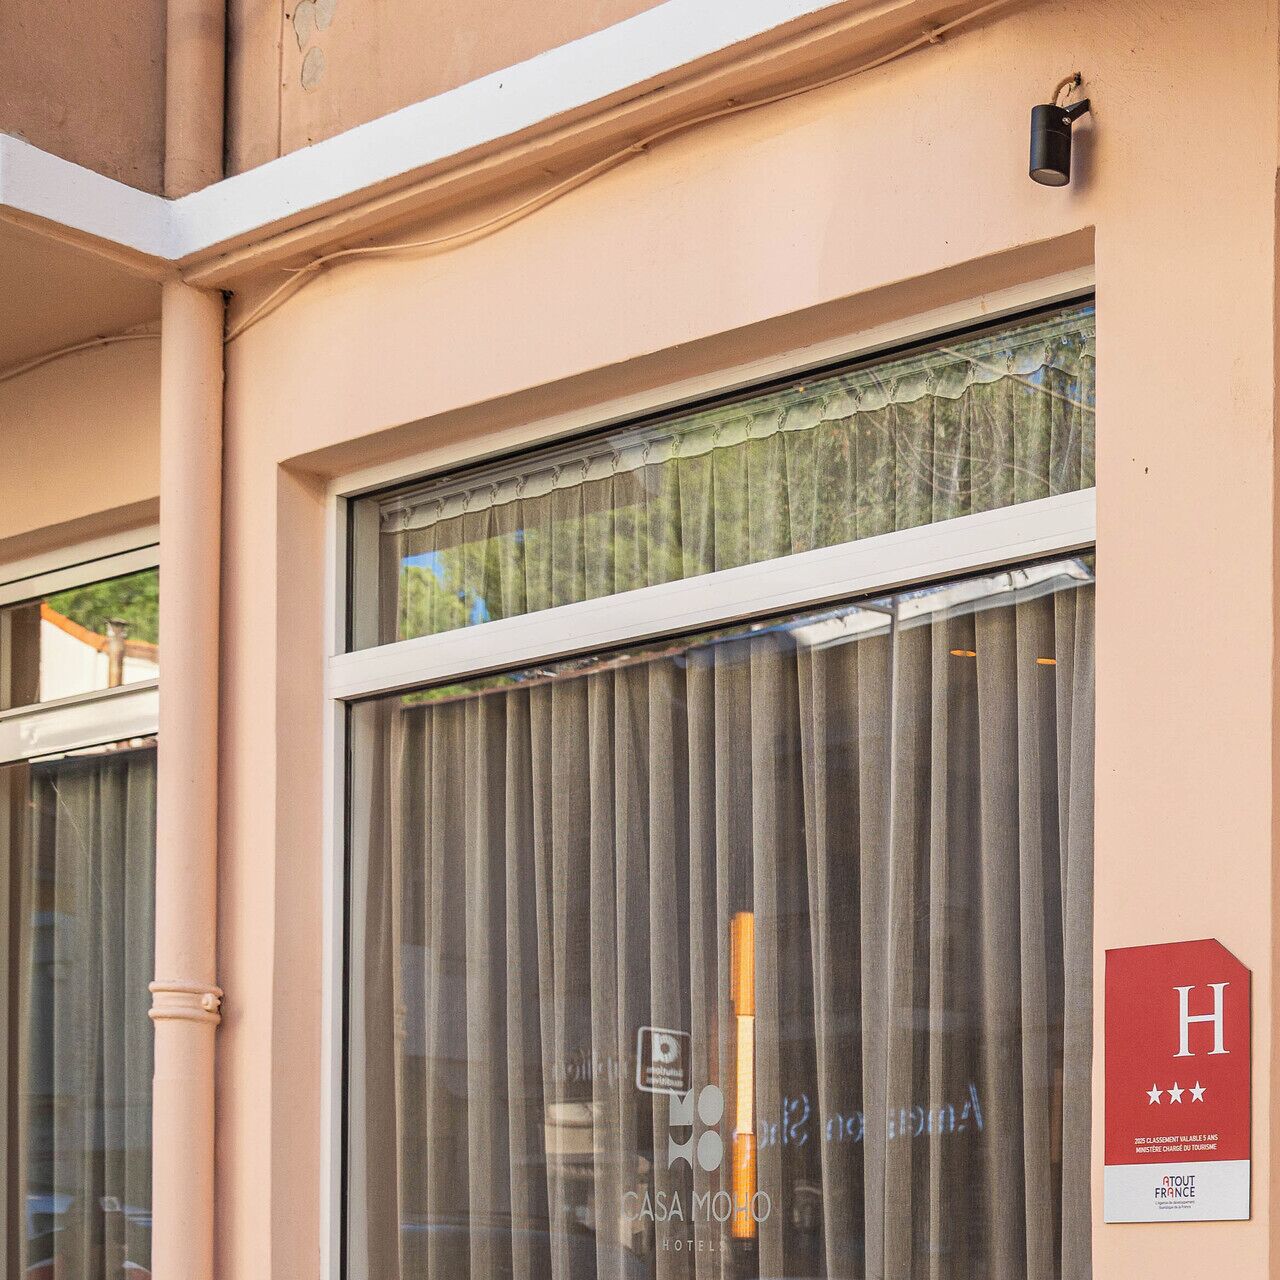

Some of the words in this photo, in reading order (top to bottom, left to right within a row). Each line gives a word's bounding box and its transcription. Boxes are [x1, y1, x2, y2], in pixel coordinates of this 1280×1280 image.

[1173, 982, 1230, 1058] H
[1146, 1136, 1180, 1144] CLASSEMENT
[1180, 1134, 1203, 1142] VALABLE
[1207, 1133, 1219, 1141] ANS
[1192, 1143, 1218, 1151] TOURISME
[1162, 1175, 1196, 1187] ATOUT
[1154, 1187, 1196, 1198] FRANCE
[622, 1191, 684, 1222] CASA
[692, 1190, 772, 1223] MOHO
